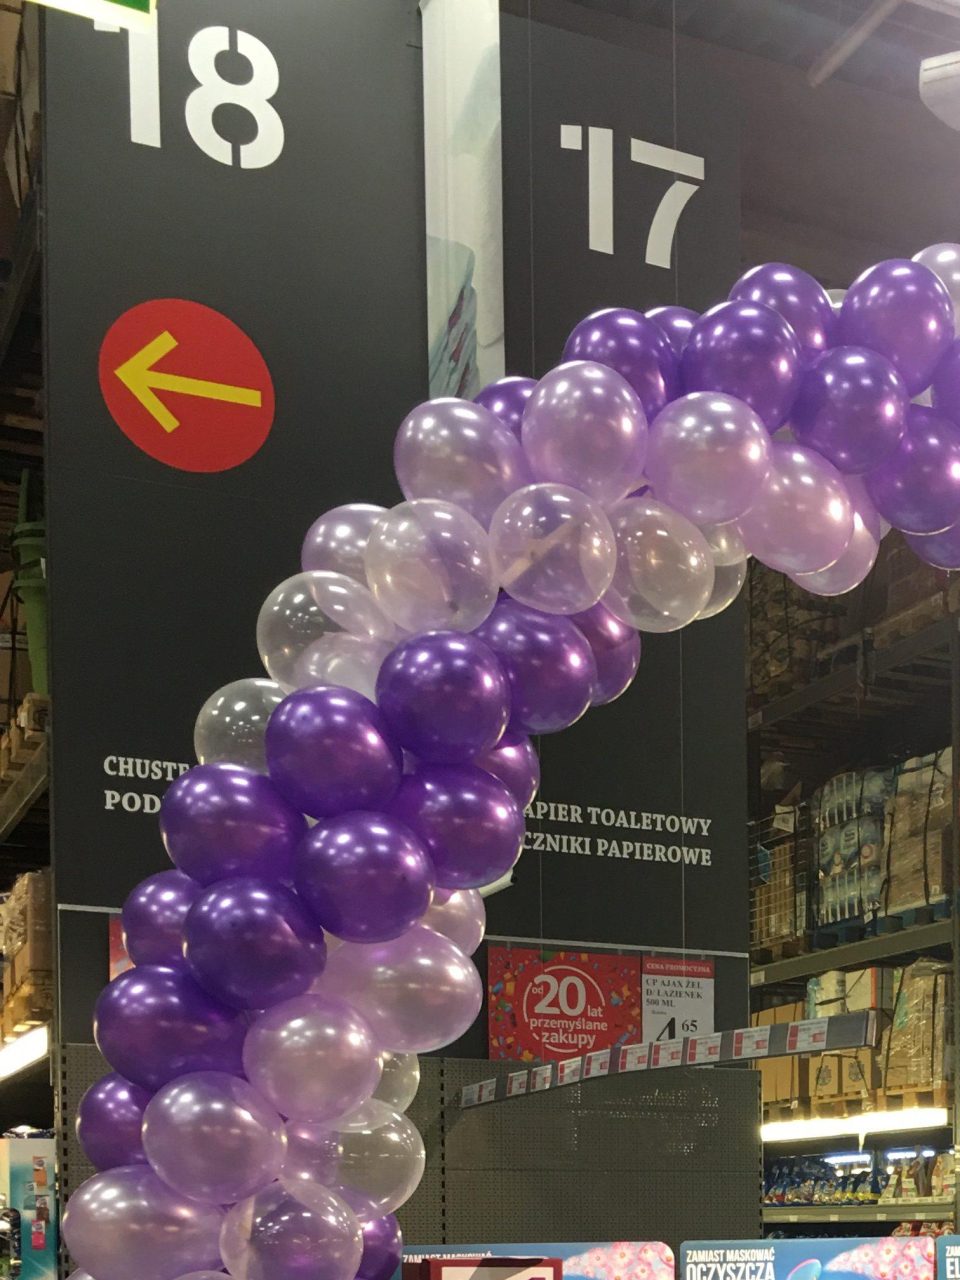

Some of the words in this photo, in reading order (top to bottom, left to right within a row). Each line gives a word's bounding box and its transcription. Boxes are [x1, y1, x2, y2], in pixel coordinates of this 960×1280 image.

[94, 20, 285, 169] 18
[560, 124, 705, 269] 17
[587, 806, 712, 836] TOALETOWY
[597, 838, 712, 866] PAPIEROWE
[532, 985, 544, 995] od
[534, 976, 586, 1017] 20
[587, 1005, 603, 1018] lat
[530, 1015, 608, 1032] przemyślane
[682, 1020, 698, 1033] 65
[541, 1028, 596, 1048] zakupy
[686, 1250, 725, 1263] ZAMIAST
[726, 1246, 775, 1261] MASKOWAĆ
